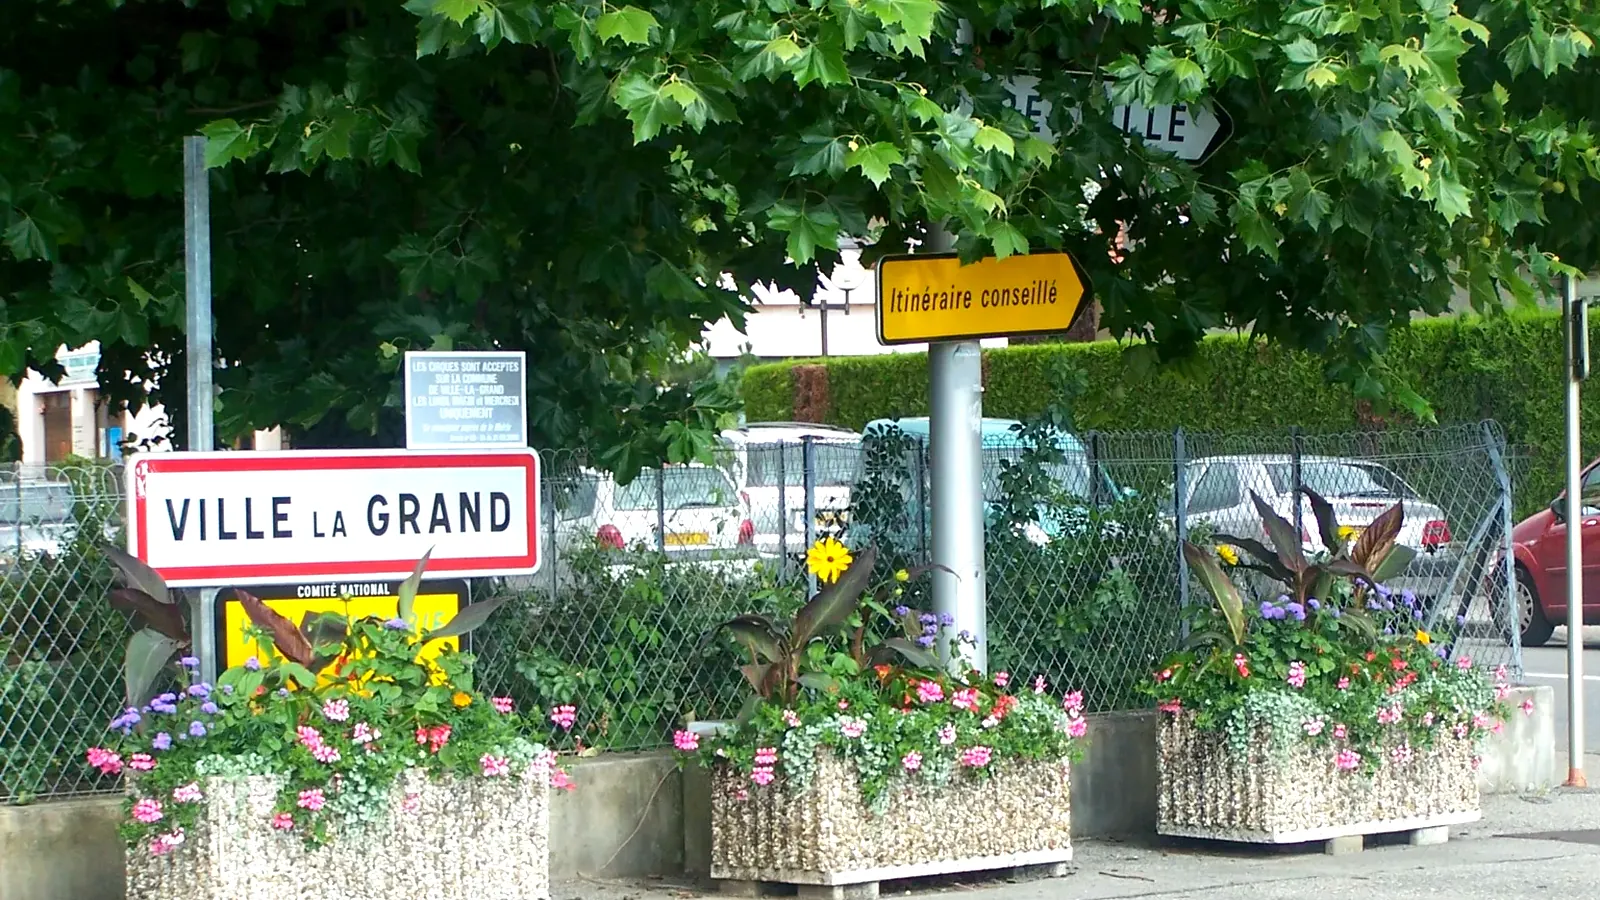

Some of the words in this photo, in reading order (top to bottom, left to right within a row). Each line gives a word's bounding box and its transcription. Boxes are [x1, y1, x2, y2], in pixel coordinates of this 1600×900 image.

[890, 285, 973, 313] Itinéraire
[981, 279, 1058, 308] conseillé
[412, 361, 427, 373] LES
[461, 361, 481, 373] SONT
[451, 373, 461, 384] LA
[428, 384, 439, 395] DE
[165, 496, 293, 541] VILLE
[313, 510, 348, 538] LA
[366, 491, 511, 537] GRAND
[297, 582, 337, 598] COMITÉ
[340, 583, 391, 597] NATIONAL
